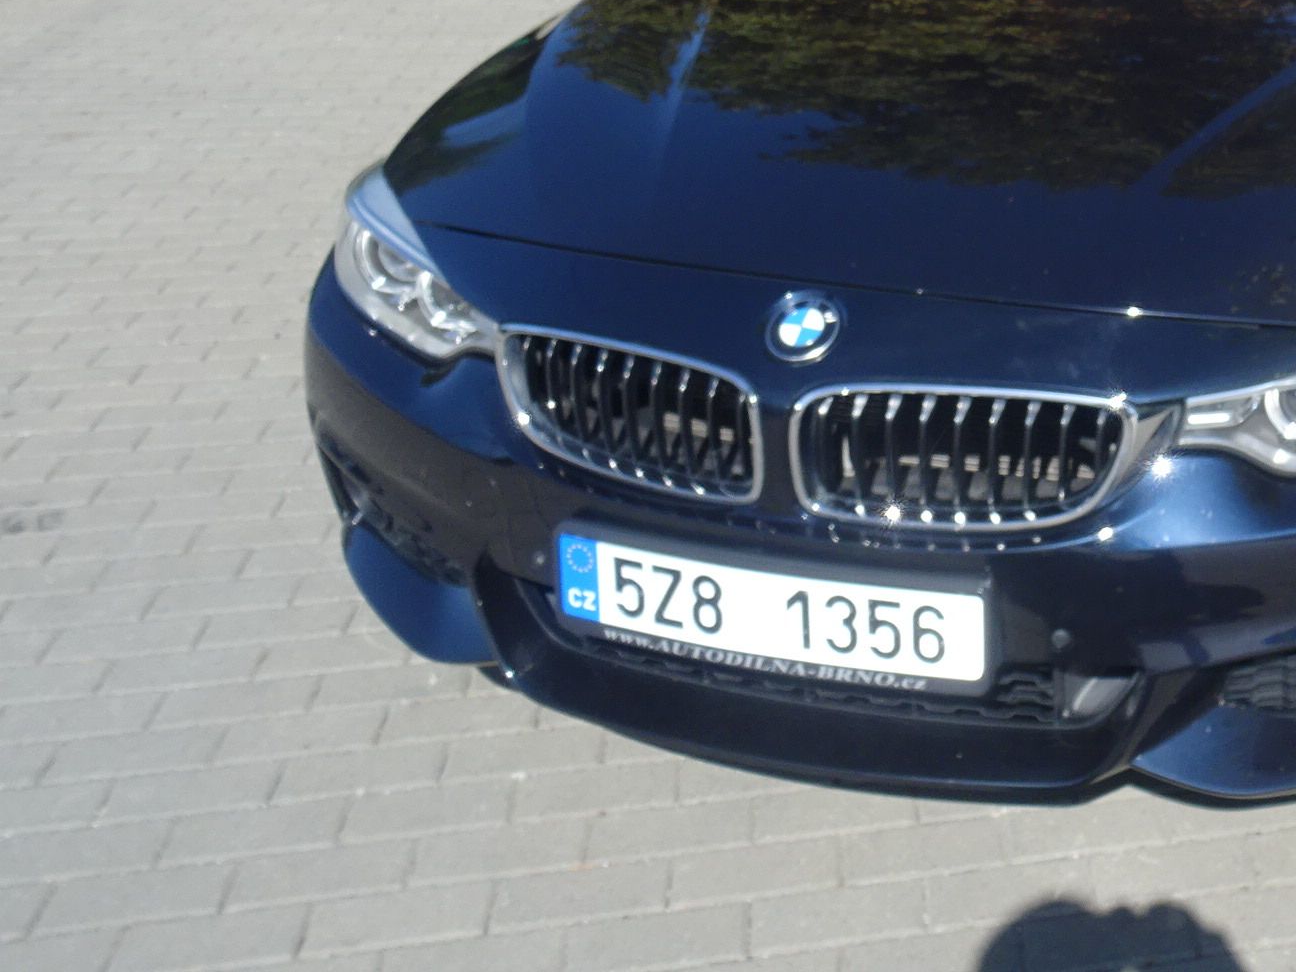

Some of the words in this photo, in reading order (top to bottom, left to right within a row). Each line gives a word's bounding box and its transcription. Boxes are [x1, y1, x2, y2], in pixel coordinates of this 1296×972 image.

[567, 586, 598, 612] CZ
[613, 557, 723, 635] 5Z8
[785, 589, 946, 665] 1356
